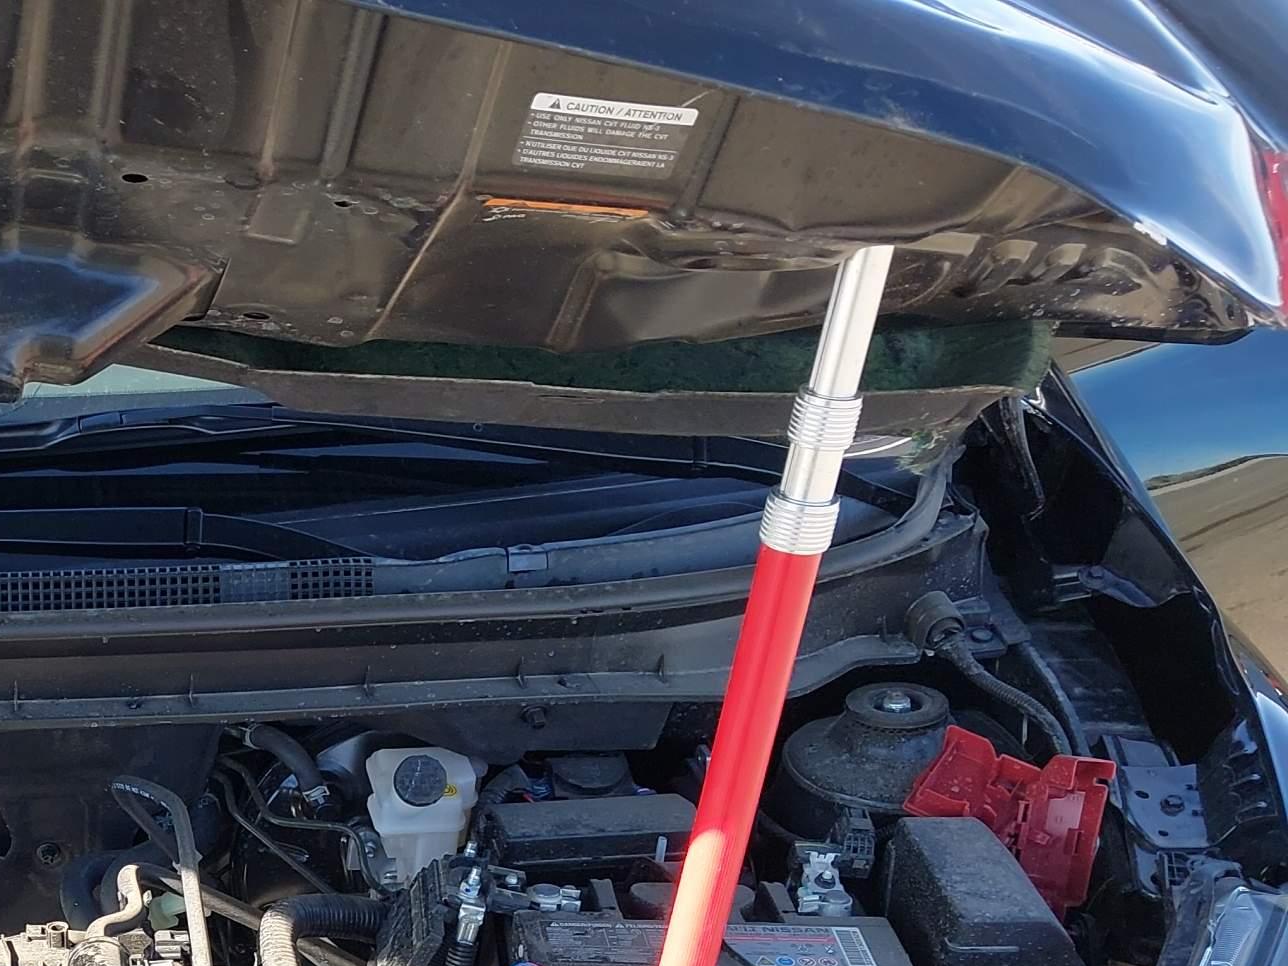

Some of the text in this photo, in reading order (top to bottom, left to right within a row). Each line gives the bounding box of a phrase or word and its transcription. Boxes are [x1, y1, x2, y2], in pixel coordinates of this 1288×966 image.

[566, 102, 614, 116] CAUTION
[623, 108, 683, 121] ATTENTION
[535, 112, 551, 120] USE
[553, 114, 573, 122] ONLY
[575, 117, 602, 125] NISSAN
[619, 121, 642, 129] FLUID
[530, 128, 584, 140] TRANSMISSION
[532, 120, 558, 129] OTHER
[559, 124, 585, 132] FLUIDS
[604, 129, 636, 138] DAMAGE
[637, 132, 654, 140] THE
[631, 151, 658, 159] NISSAN
[519, 156, 571, 167] TRANSMISSION
[760, 926, 832, 935] NISSAN
